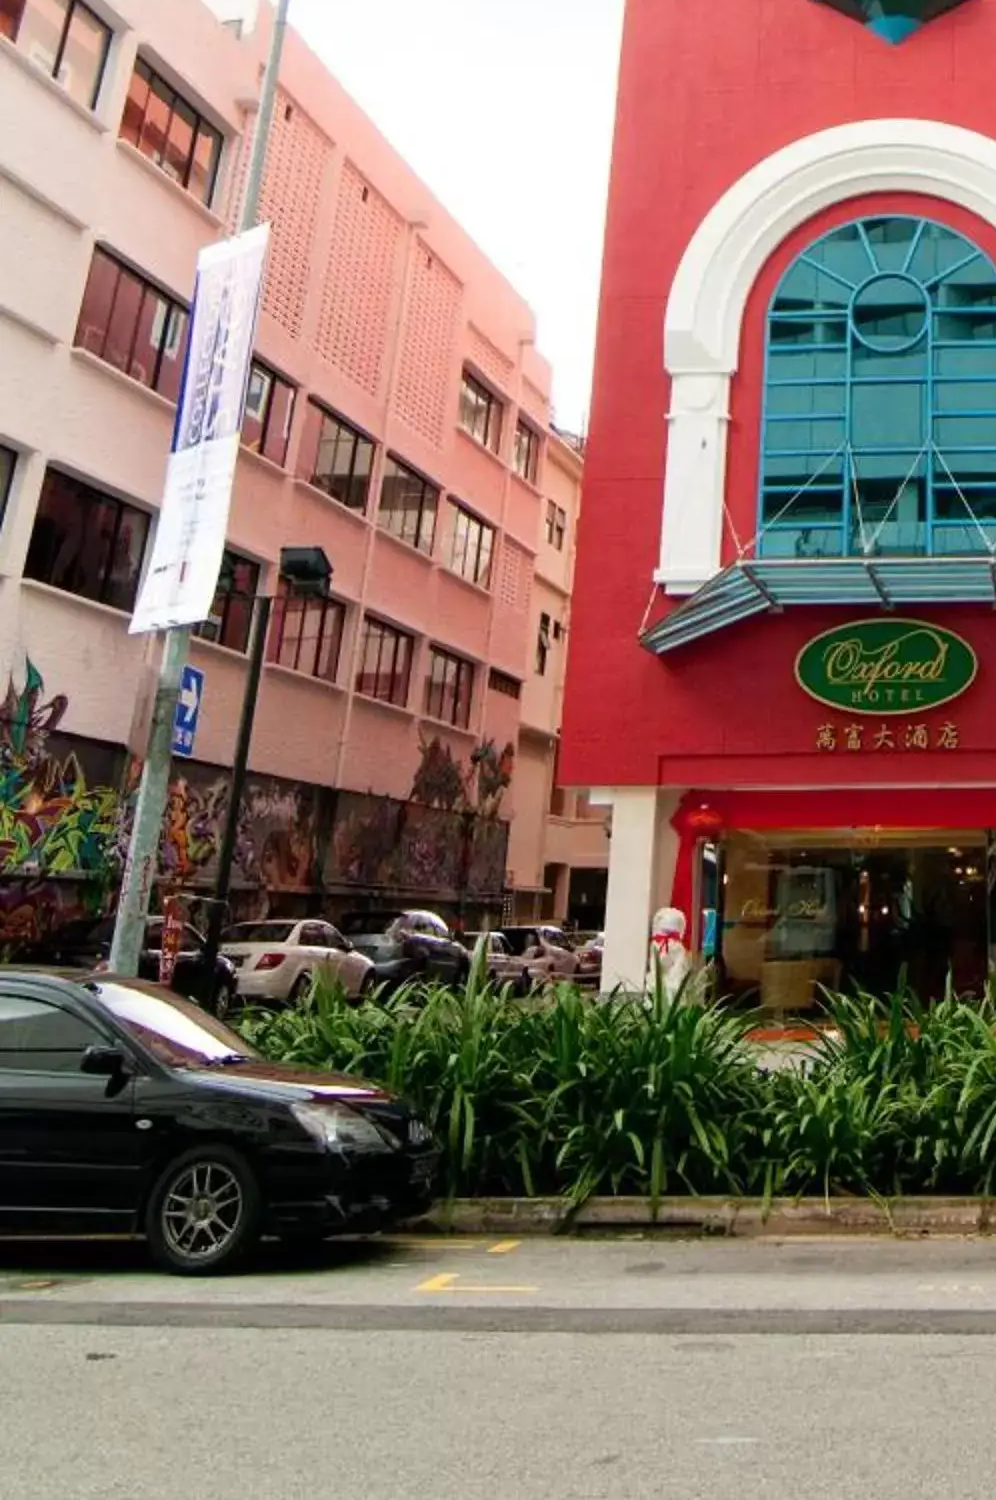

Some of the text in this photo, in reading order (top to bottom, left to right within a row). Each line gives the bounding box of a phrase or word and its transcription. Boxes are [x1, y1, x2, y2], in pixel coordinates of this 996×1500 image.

[822, 629, 949, 694] Oxford
[852, 689, 925, 702] HOTEL
[815, 721, 959, 749] 萬富大酒店
